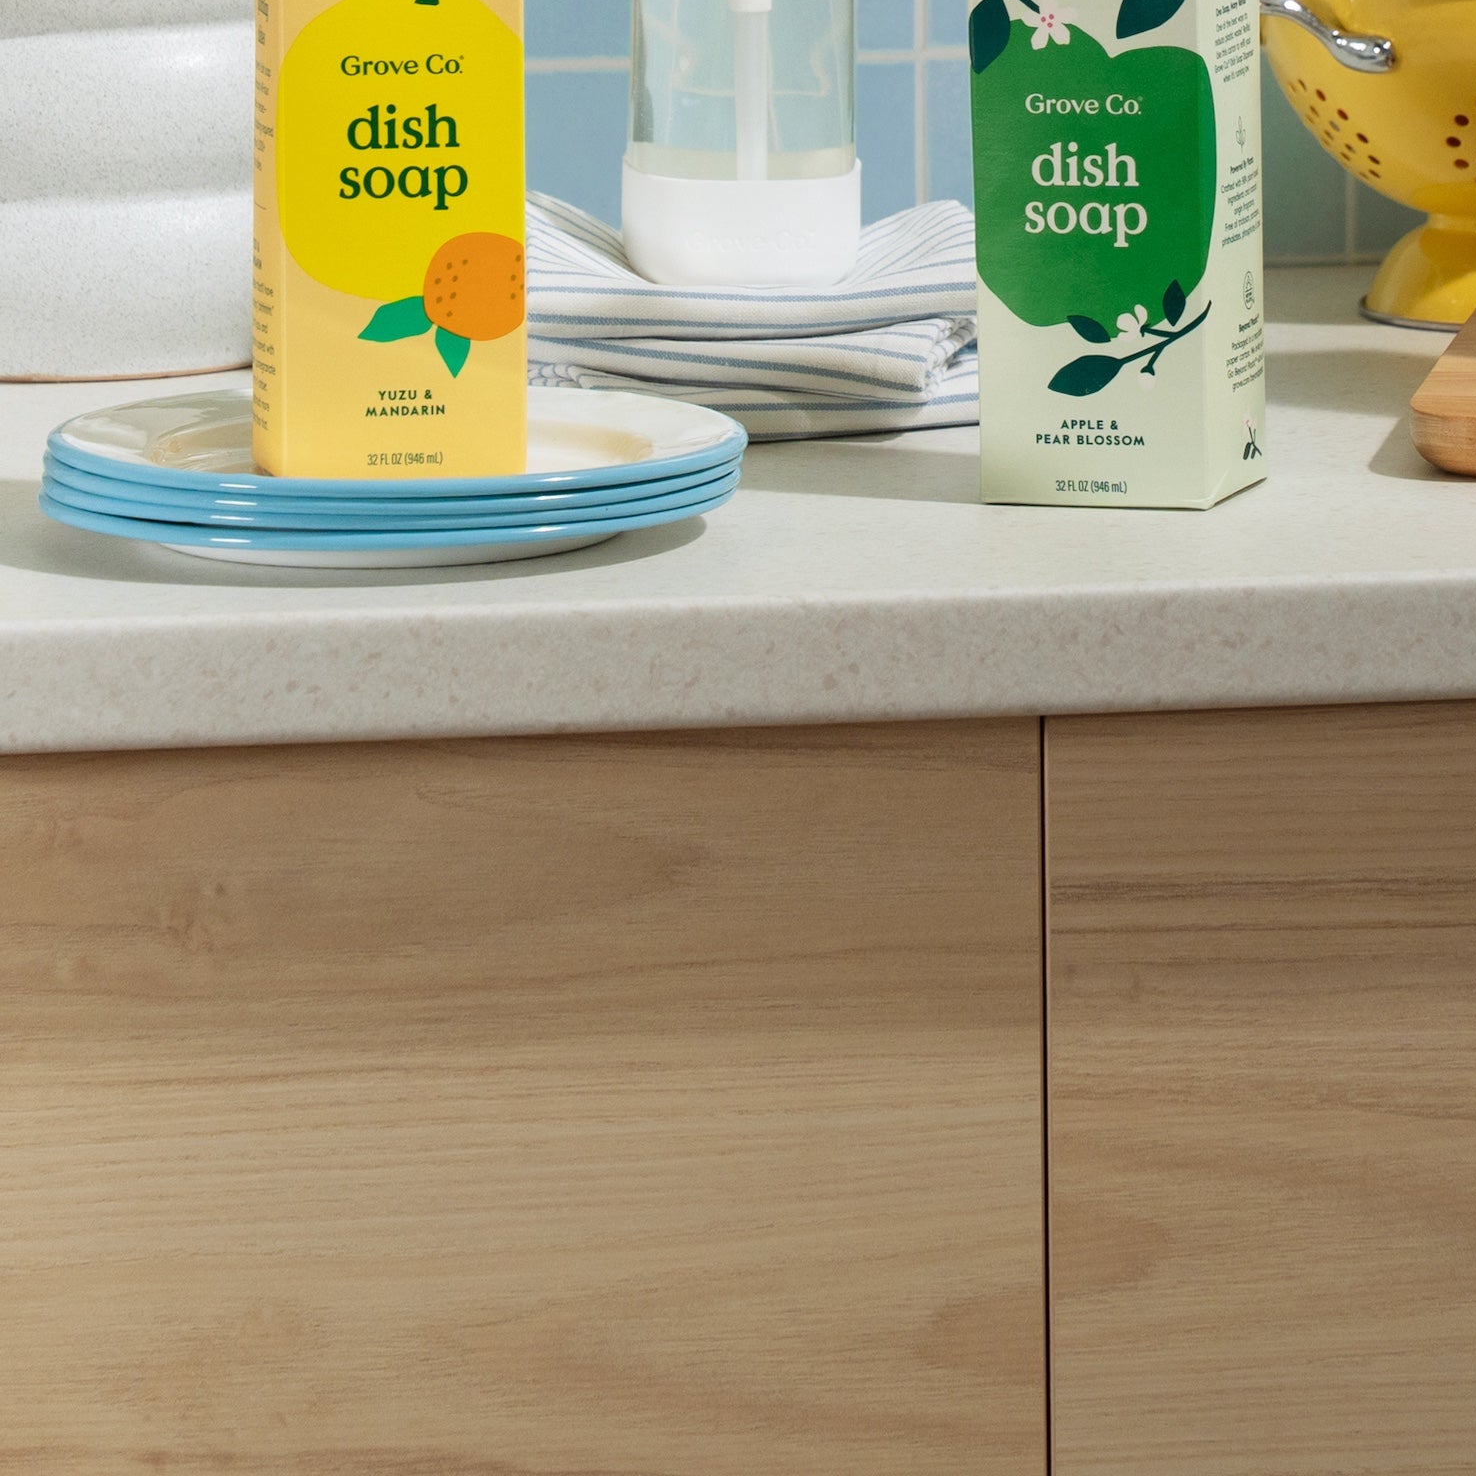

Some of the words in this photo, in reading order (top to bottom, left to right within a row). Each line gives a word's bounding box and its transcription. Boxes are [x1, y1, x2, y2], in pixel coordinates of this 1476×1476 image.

[340, 55, 419, 77] Grove
[1025, 93, 1099, 115] Grove
[347, 103, 460, 151] dish
[1031, 141, 1140, 188] dish
[339, 164, 469, 211] soap
[1024, 201, 1148, 248] soap
[378, 389, 417, 401] YUZU
[424, 389, 432, 400] &
[365, 404, 445, 417] MANDARIN
[1060, 419, 1104, 430] APPLE
[1110, 419, 1118, 431] &
[1036, 433, 1070, 445] PEAR
[1076, 434, 1145, 446] BLOSSOM
[367, 453, 379, 466] 32
[379, 453, 389, 466] FL
[391, 452, 403, 466] OZ
[404, 452, 425, 466] (946
[426, 451, 443, 465] mL)
[1055, 479, 1066, 492] 32
[1067, 479, 1077, 492] FL
[1078, 480, 1089, 492] OZ
[1090, 480, 1110, 494] (946
[1111, 481, 1128, 494] mL)
